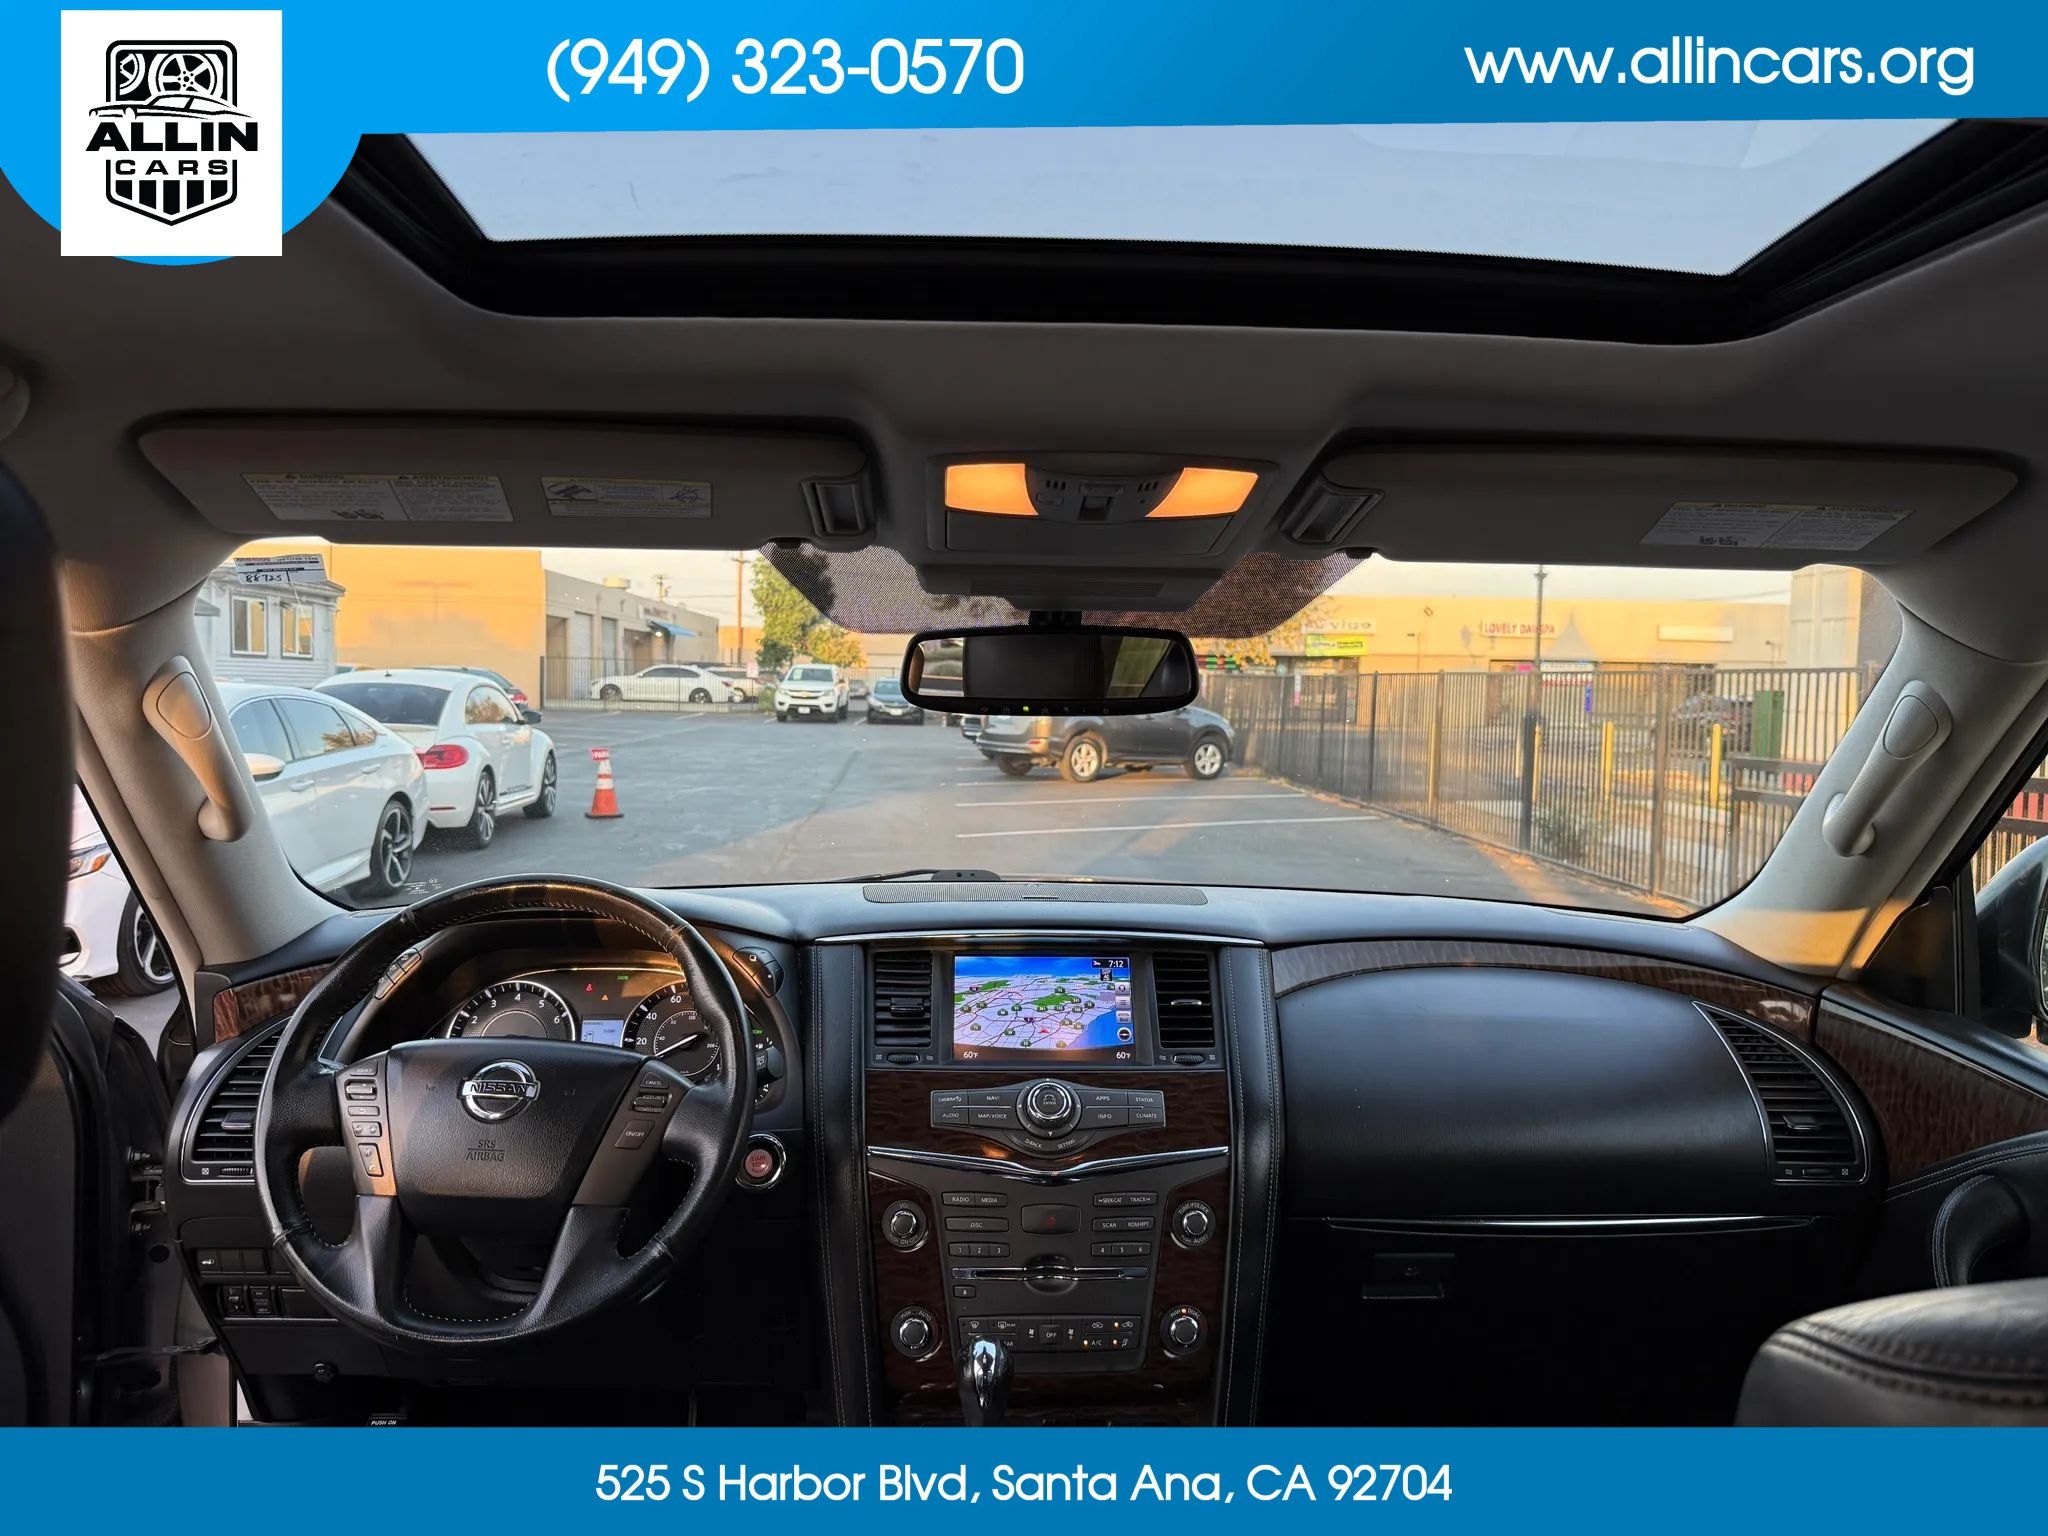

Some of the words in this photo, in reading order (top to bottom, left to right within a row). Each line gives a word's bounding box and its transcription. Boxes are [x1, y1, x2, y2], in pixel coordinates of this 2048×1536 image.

[1484, 623, 1517, 633] LOVELY
[1109, 960, 1123, 968] 7:12
[514, 993, 521, 1001] 4
[670, 995, 682, 1003] 60
[491, 1000, 497, 1008] 3
[539, 1000, 545, 1008] 5
[471, 1016, 478, 1024] 2
[554, 1016, 560, 1024] 6
[646, 1012, 657, 1020] 40
[470, 1082, 527, 1094] NISSAN
[478, 1140, 497, 1149] SRS
[467, 1153, 505, 1162] AIRBAG
